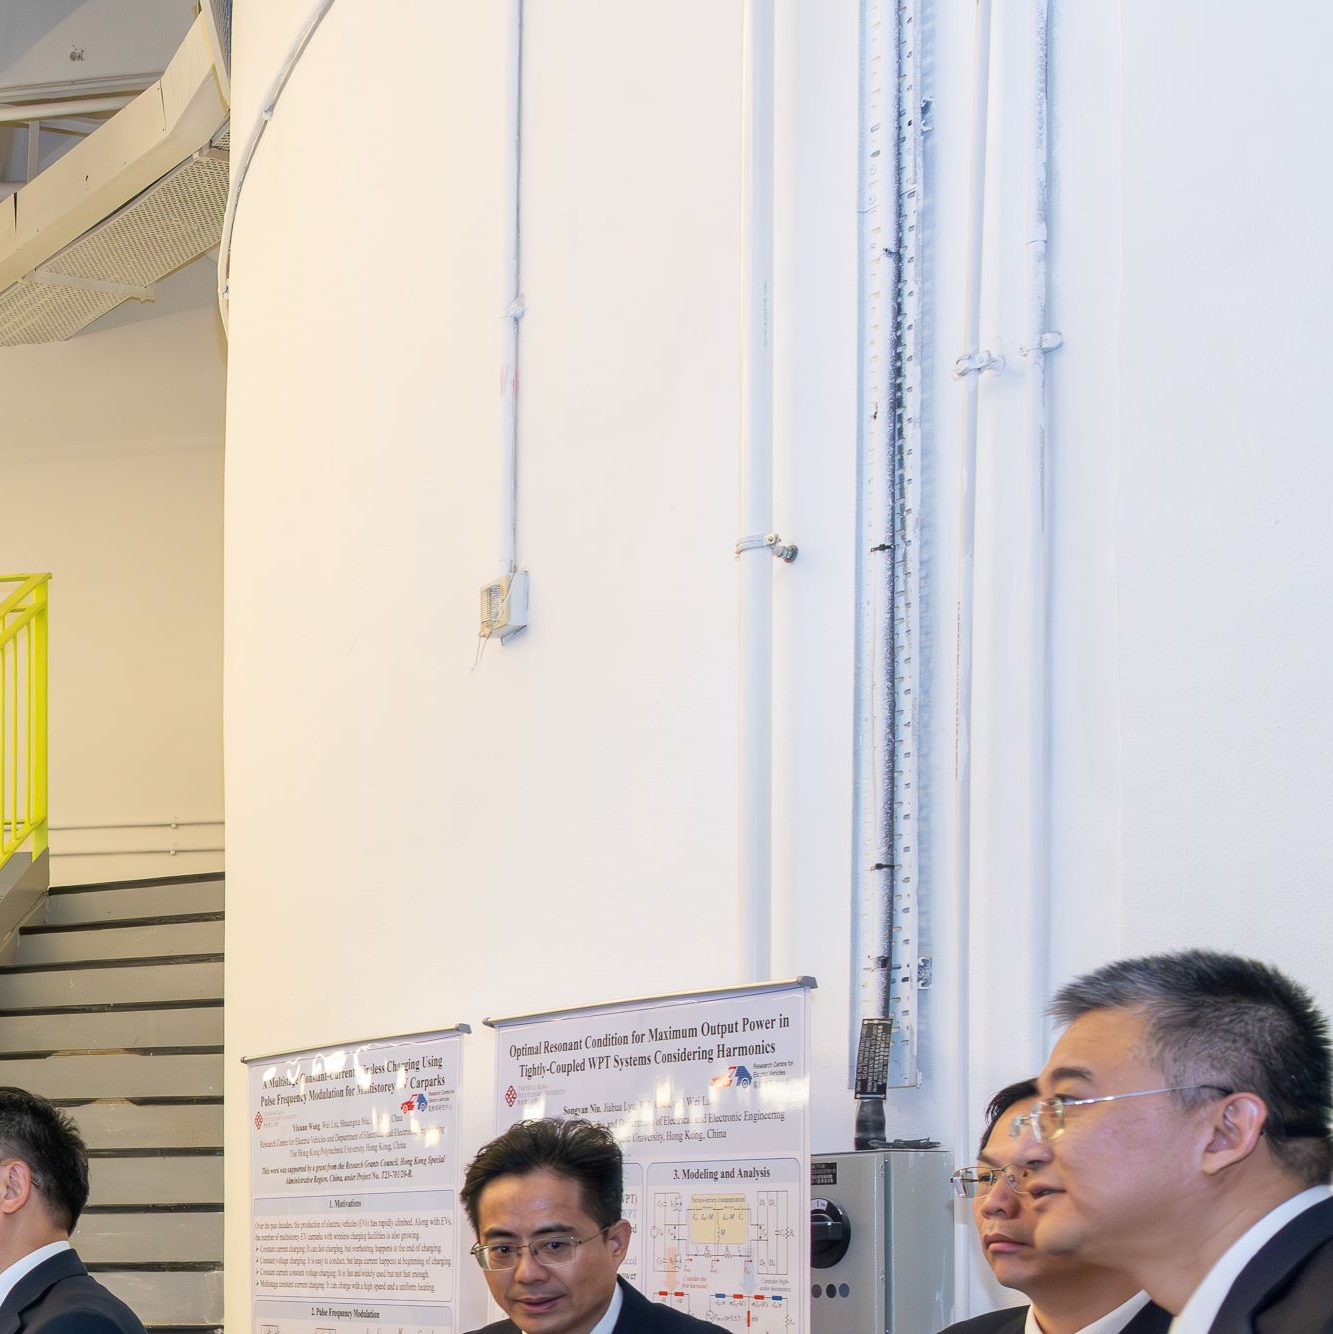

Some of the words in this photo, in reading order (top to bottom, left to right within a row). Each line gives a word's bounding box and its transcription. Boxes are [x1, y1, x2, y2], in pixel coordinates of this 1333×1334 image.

[509, 1042, 542, 1061] Optimal
[543, 1040, 583, 1054] Resonant
[585, 1033, 629, 1049] Condition
[631, 1030, 646, 1044] for
[648, 1026, 698, 1042] Maximum
[701, 1021, 739, 1039] Output
[742, 1018, 776, 1032] Power
[779, 1013, 789, 1028] in
[262, 1081, 268, 1090] A
[422, 1055, 443, 1070] Using
[519, 1058, 586, 1081] Tightly-Coupled
[588, 1055, 611, 1070] WPT
[613, 1055, 652, 1071] Systems
[654, 1046, 714, 1065] Considering
[717, 1040, 776, 1059] Harmonics
[261, 1095, 276, 1107] Pulse
[309, 1087, 344, 1101] Modulation
[345, 1085, 356, 1097] for
[410, 1074, 445, 1091] Carparks
[708, 1112, 742, 1123] Electronic
[744, 1110, 785, 1124] Engineering
[666, 1131, 684, 1143] Hong
[685, 1130, 706, 1142] Kong,
[706, 1129, 727, 1139] China
[365, 1160, 379, 1168] Grants
[400, 1157, 413, 1167] Hong
[413, 1156, 429, 1166] Kong
[427, 1155, 446, 1166] Special
[673, 1169, 680, 1180] 3.
[682, 1168, 719, 1182] Modeling
[720, 1168, 735, 1179] and
[737, 1167, 771, 1181] Analysis
